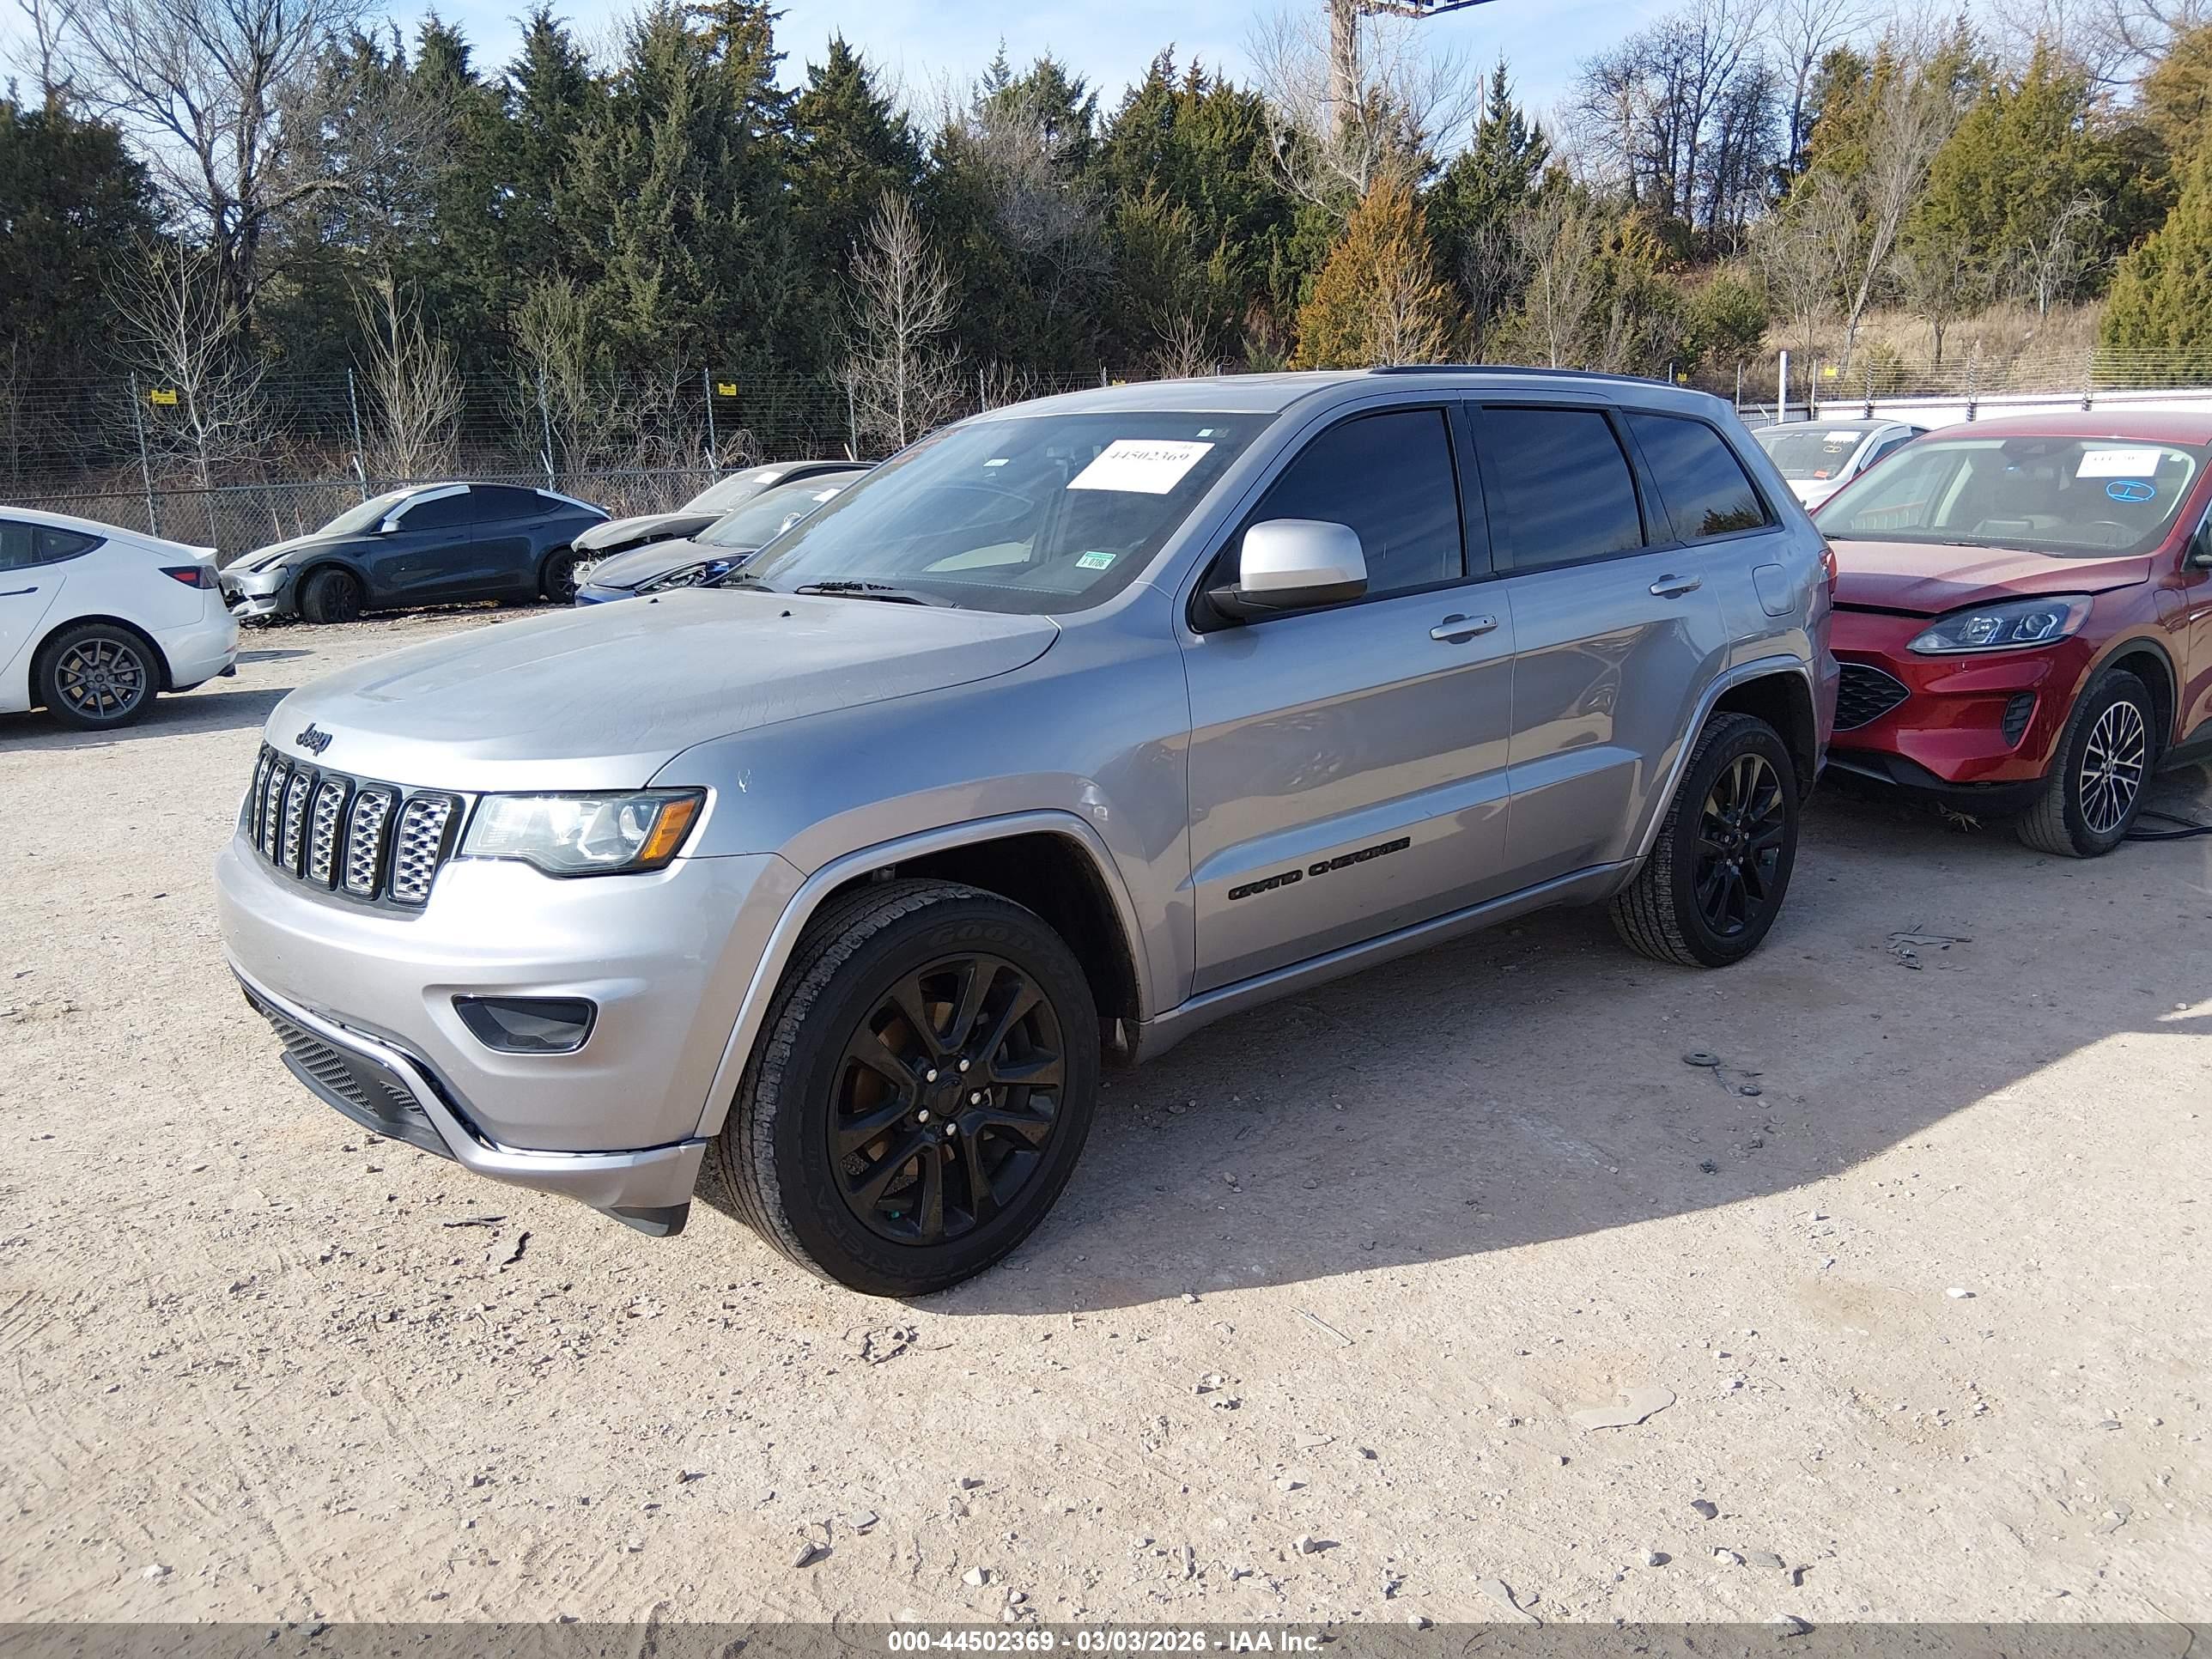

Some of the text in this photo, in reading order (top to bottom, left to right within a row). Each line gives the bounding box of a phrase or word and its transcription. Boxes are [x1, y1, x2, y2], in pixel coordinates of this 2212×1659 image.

[1109, 450, 1190, 462] 44502369
[295, 721, 333, 757] Jeep
[1228, 836, 1411, 901] GRAND CHEROKEE
